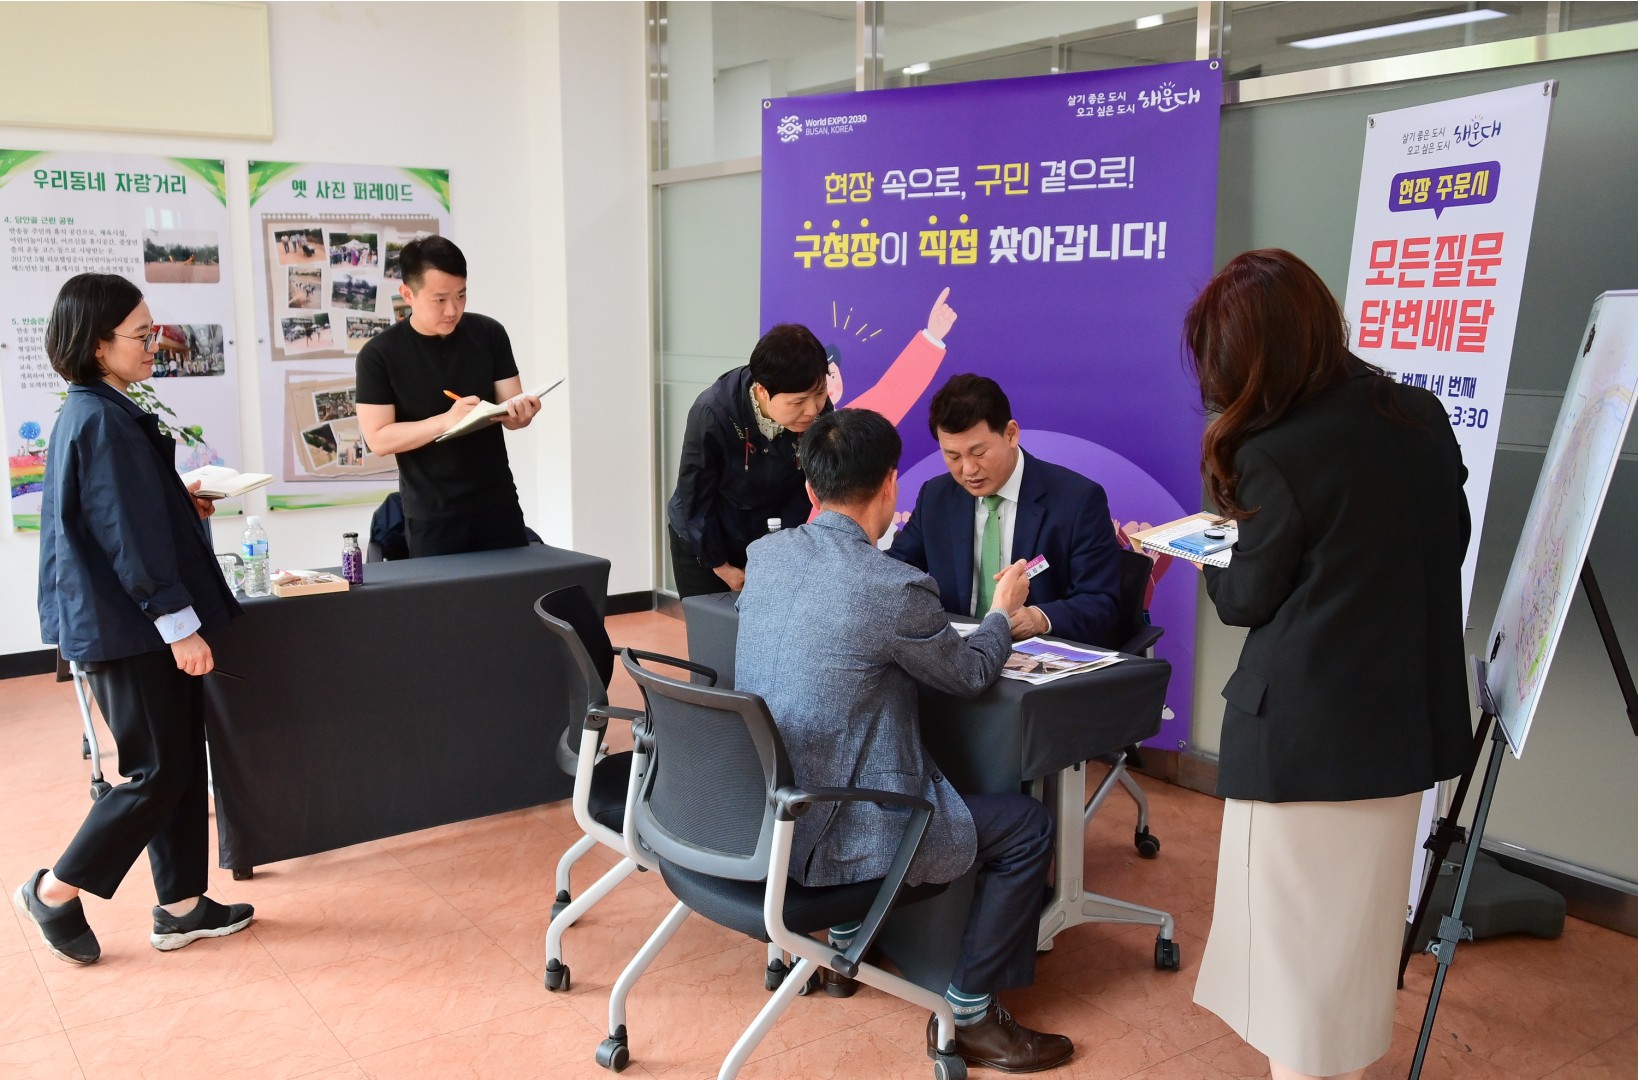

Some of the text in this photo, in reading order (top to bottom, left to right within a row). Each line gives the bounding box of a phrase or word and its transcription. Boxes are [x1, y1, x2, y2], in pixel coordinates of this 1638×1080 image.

[1067, 91, 1126, 106] 살기 좋은 도시
[1138, 86, 1200, 112] 해운대
[805, 114, 867, 128] World EXPO 2030
[1076, 104, 1135, 118] 오고 싶은 도시
[805, 125, 854, 136] BUSAN, KOREA
[1402, 126, 1446, 145] 살기 좋은 도시
[1453, 120, 1502, 148] 해운대
[1406, 140, 1451, 156] 오고 싶은 도시
[33, 169, 187, 194] 우리동네 자랑거리
[291, 179, 414, 202] 옛 사진 퍼레이드
[824, 156, 1136, 205] 현장 속으로, 구민 곁으로!
[1398, 169, 1490, 206] 현장 주문시
[4, 216, 12, 224] 4.
[59, 217, 74, 225] 공원
[793, 220, 1168, 268] 구청장이 직접 찾아갑니다!
[11, 256, 32, 264] 2017년
[1364, 232, 1504, 288] 모든질문
[12, 318, 20, 326] 5.
[1358, 298, 1495, 353] 답변배달
[1430, 374, 1445, 397] 네
[1447, 375, 1478, 400] 번째
